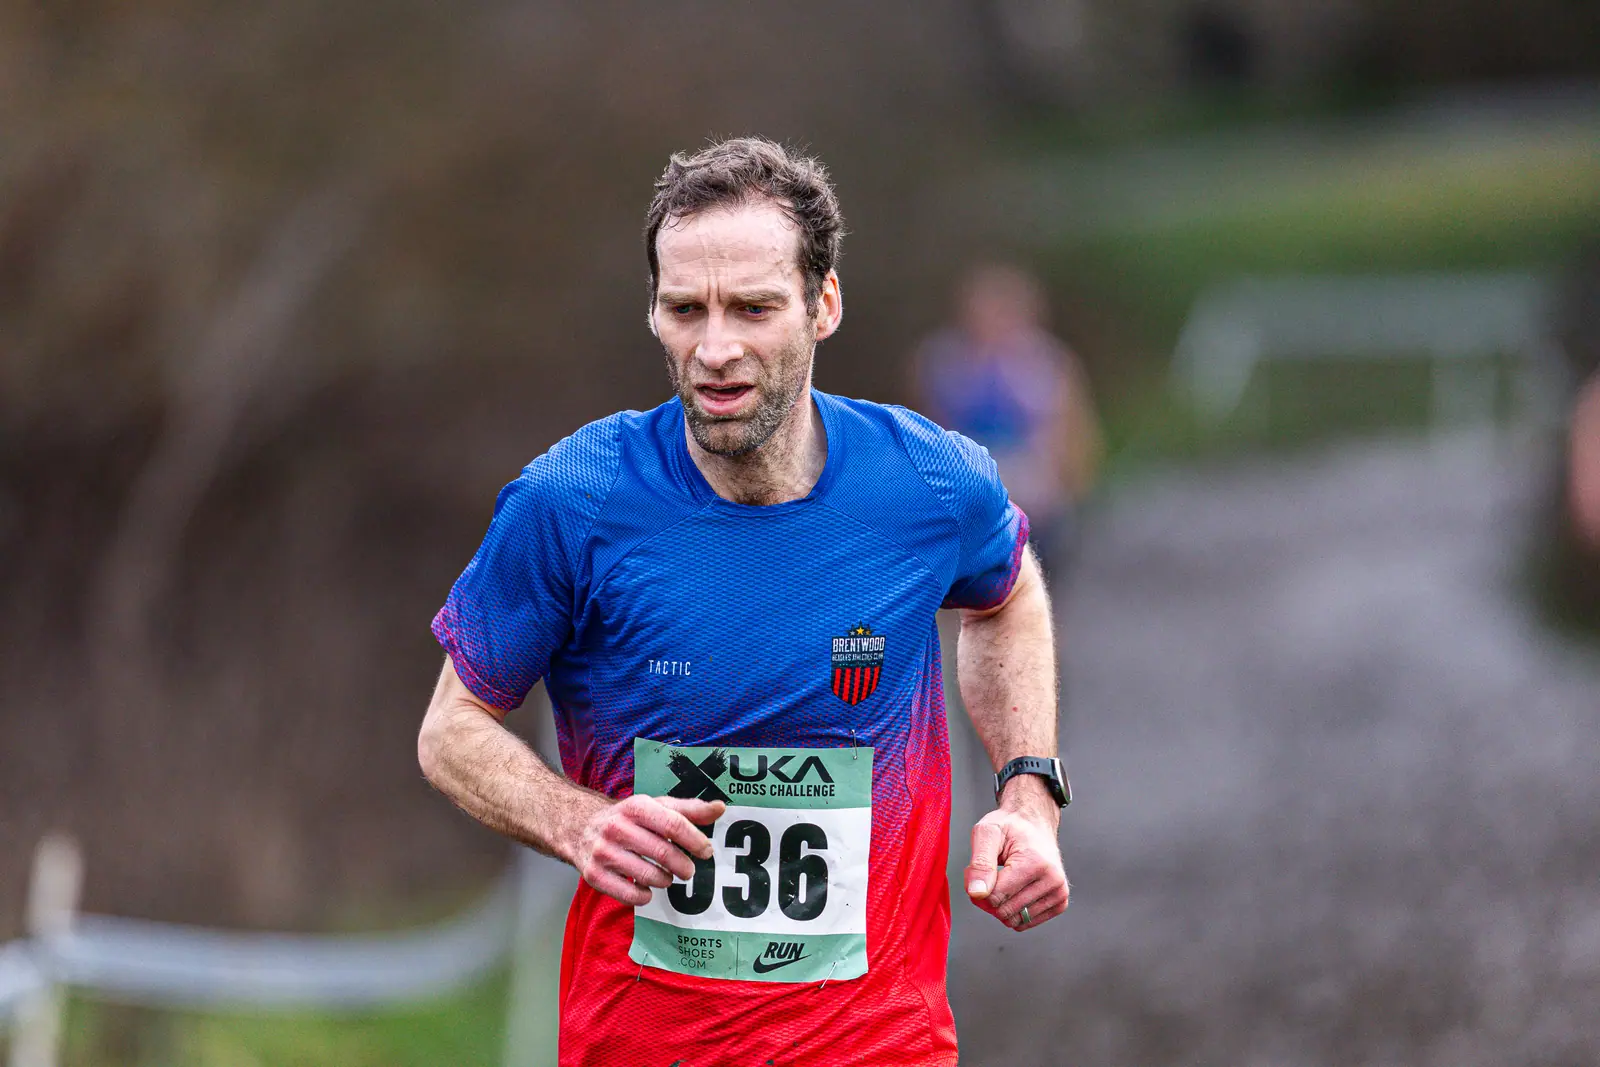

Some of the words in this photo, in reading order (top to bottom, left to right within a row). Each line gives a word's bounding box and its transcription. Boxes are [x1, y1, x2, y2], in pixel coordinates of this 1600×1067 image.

[832, 637, 885, 652] BRENTWOOD
[648, 659, 691, 676] TACTIC
[729, 754, 835, 784] UKA
[728, 782, 767, 797] CROSS
[769, 783, 836, 798] CHALLENGE
[677, 935, 722, 949] SPORTS
[678, 945, 715, 960] SHOES
[764, 941, 806, 960] RUN
[678, 957, 706, 970] .COM
